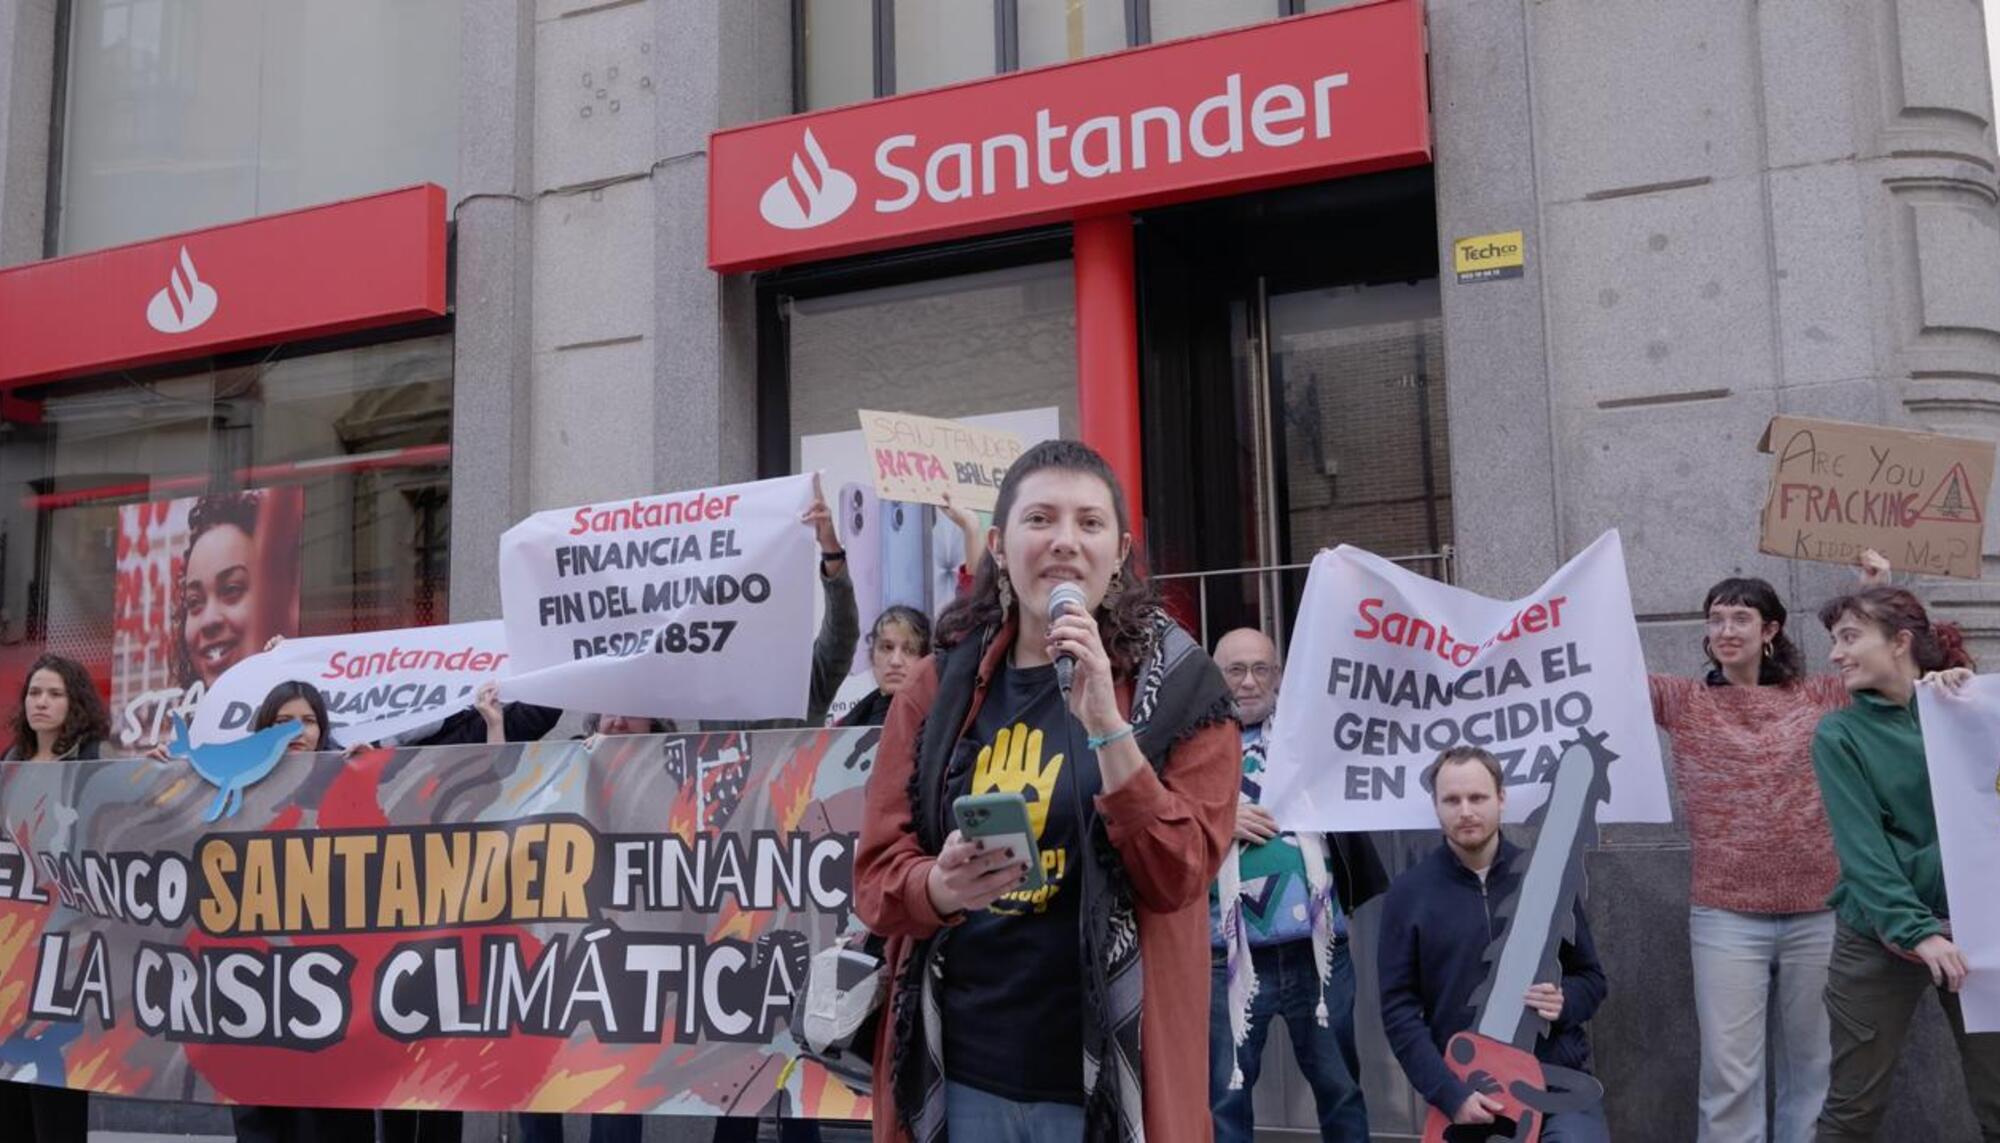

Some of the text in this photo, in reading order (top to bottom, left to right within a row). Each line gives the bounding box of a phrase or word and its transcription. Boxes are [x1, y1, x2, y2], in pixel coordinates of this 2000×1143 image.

[875, 73, 1349, 214] Santander
[953, 460, 1007, 489] BALLE
[1869, 446, 1925, 488] YOU
[569, 493, 740, 535] Santander
[1780, 483, 1921, 529] FRACKING
[556, 529, 742, 578] FINANCIA EL
[539, 573, 771, 626] FIN DEL MUNDO
[573, 620, 738, 661] DESDE 1857
[1354, 596, 1567, 668] Santader
[320, 646, 509, 680] Santander
[1328, 642, 1592, 710] FINANCIA EL
[1333, 691, 1593, 756] GENOCIDIO
[1344, 765, 1406, 801] EN
[0, 820, 859, 933] EL BANCO SANTANDER FINANC
[33, 927, 795, 1040] LA CRISIS CLIMÁTICA
